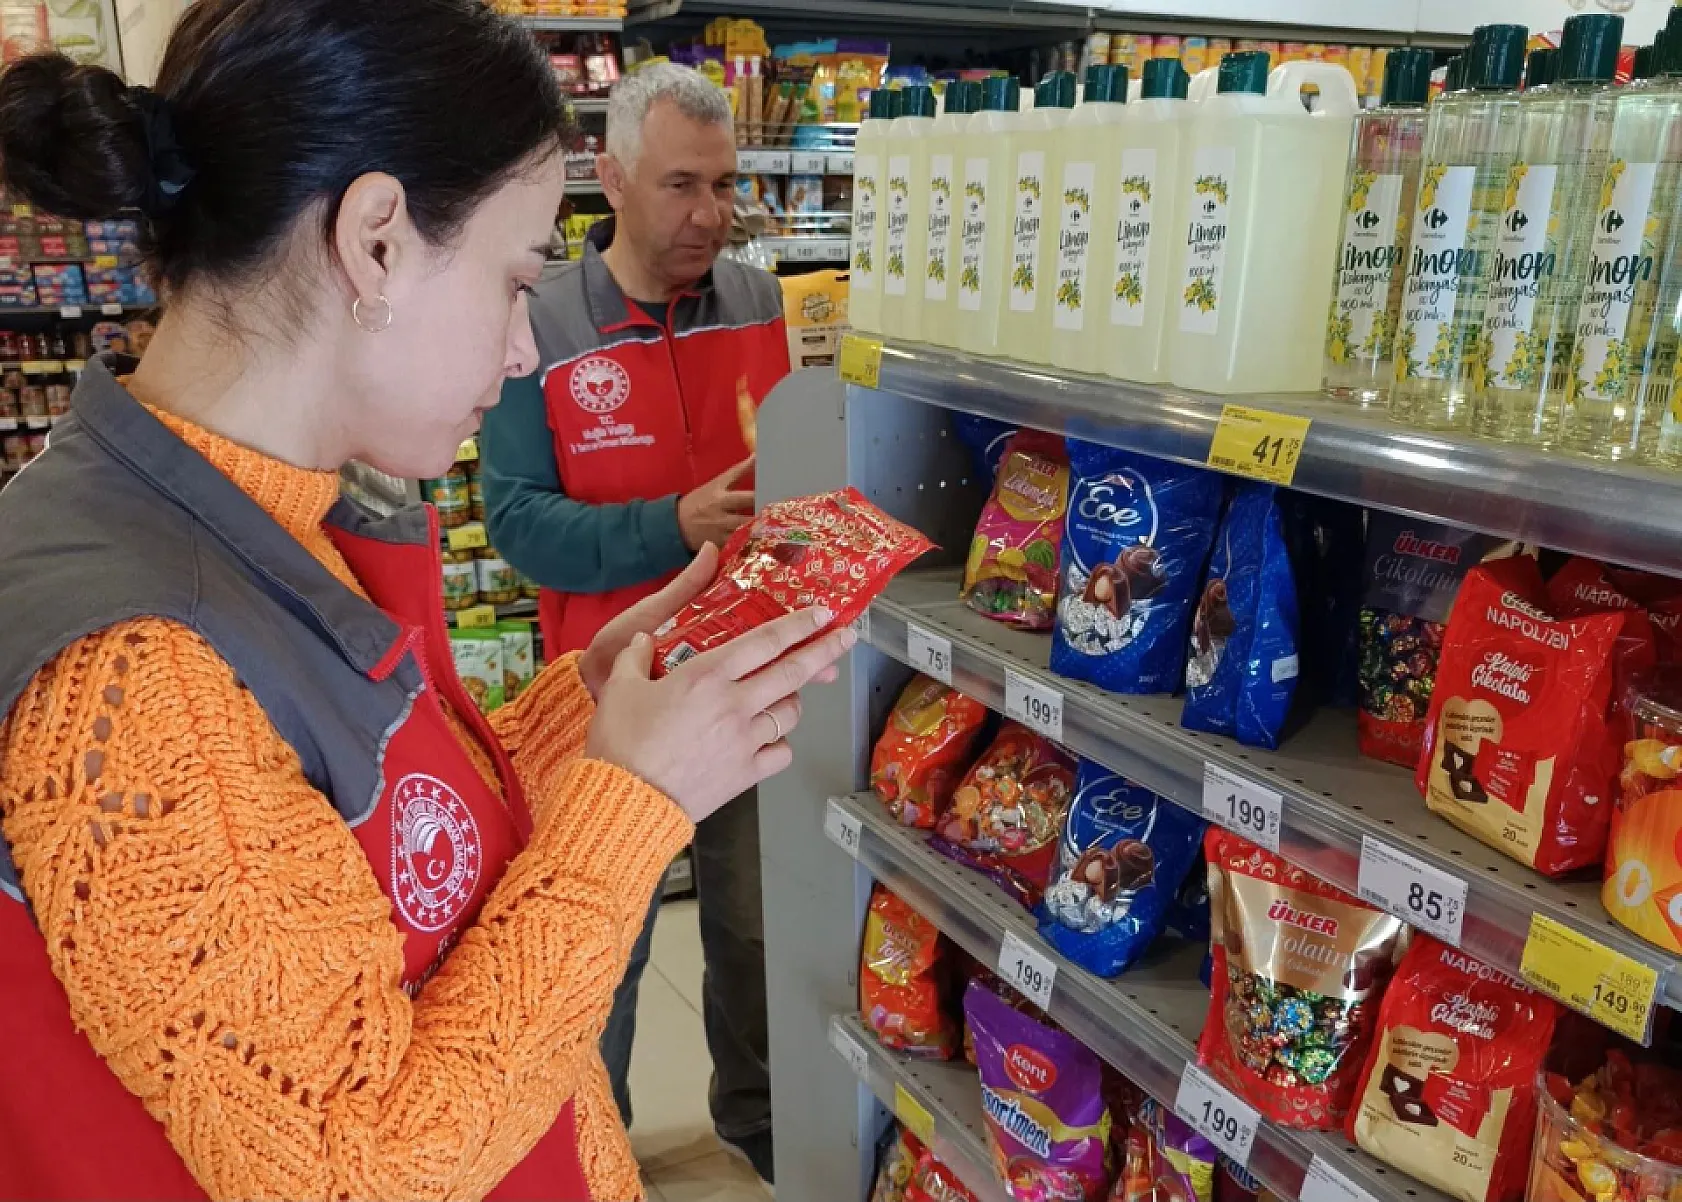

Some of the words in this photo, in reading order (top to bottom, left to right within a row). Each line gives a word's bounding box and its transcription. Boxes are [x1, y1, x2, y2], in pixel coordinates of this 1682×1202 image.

[1060, 228, 1088, 251] Limon
[1117, 219, 1150, 242] Limon
[1187, 222, 1226, 245] Limon
[1253, 435, 1284, 467] 41
[1079, 481, 1142, 526] Ece
[1393, 530, 1461, 565] ÜLKER
[926, 647, 943, 672] 75
[1022, 694, 1050, 725] 199
[1090, 788, 1143, 820] Ece
[1226, 793, 1265, 831] 199
[840, 821, 853, 845] 75
[1502, 826, 1517, 841] 20
[1408, 882, 1443, 920] 85
[1266, 899, 1339, 938] ÜLKER
[1016, 959, 1041, 992] 199
[1593, 984, 1628, 1014] 149
[1202, 1099, 1238, 1142] 199
[1452, 1151, 1468, 1167] 20
